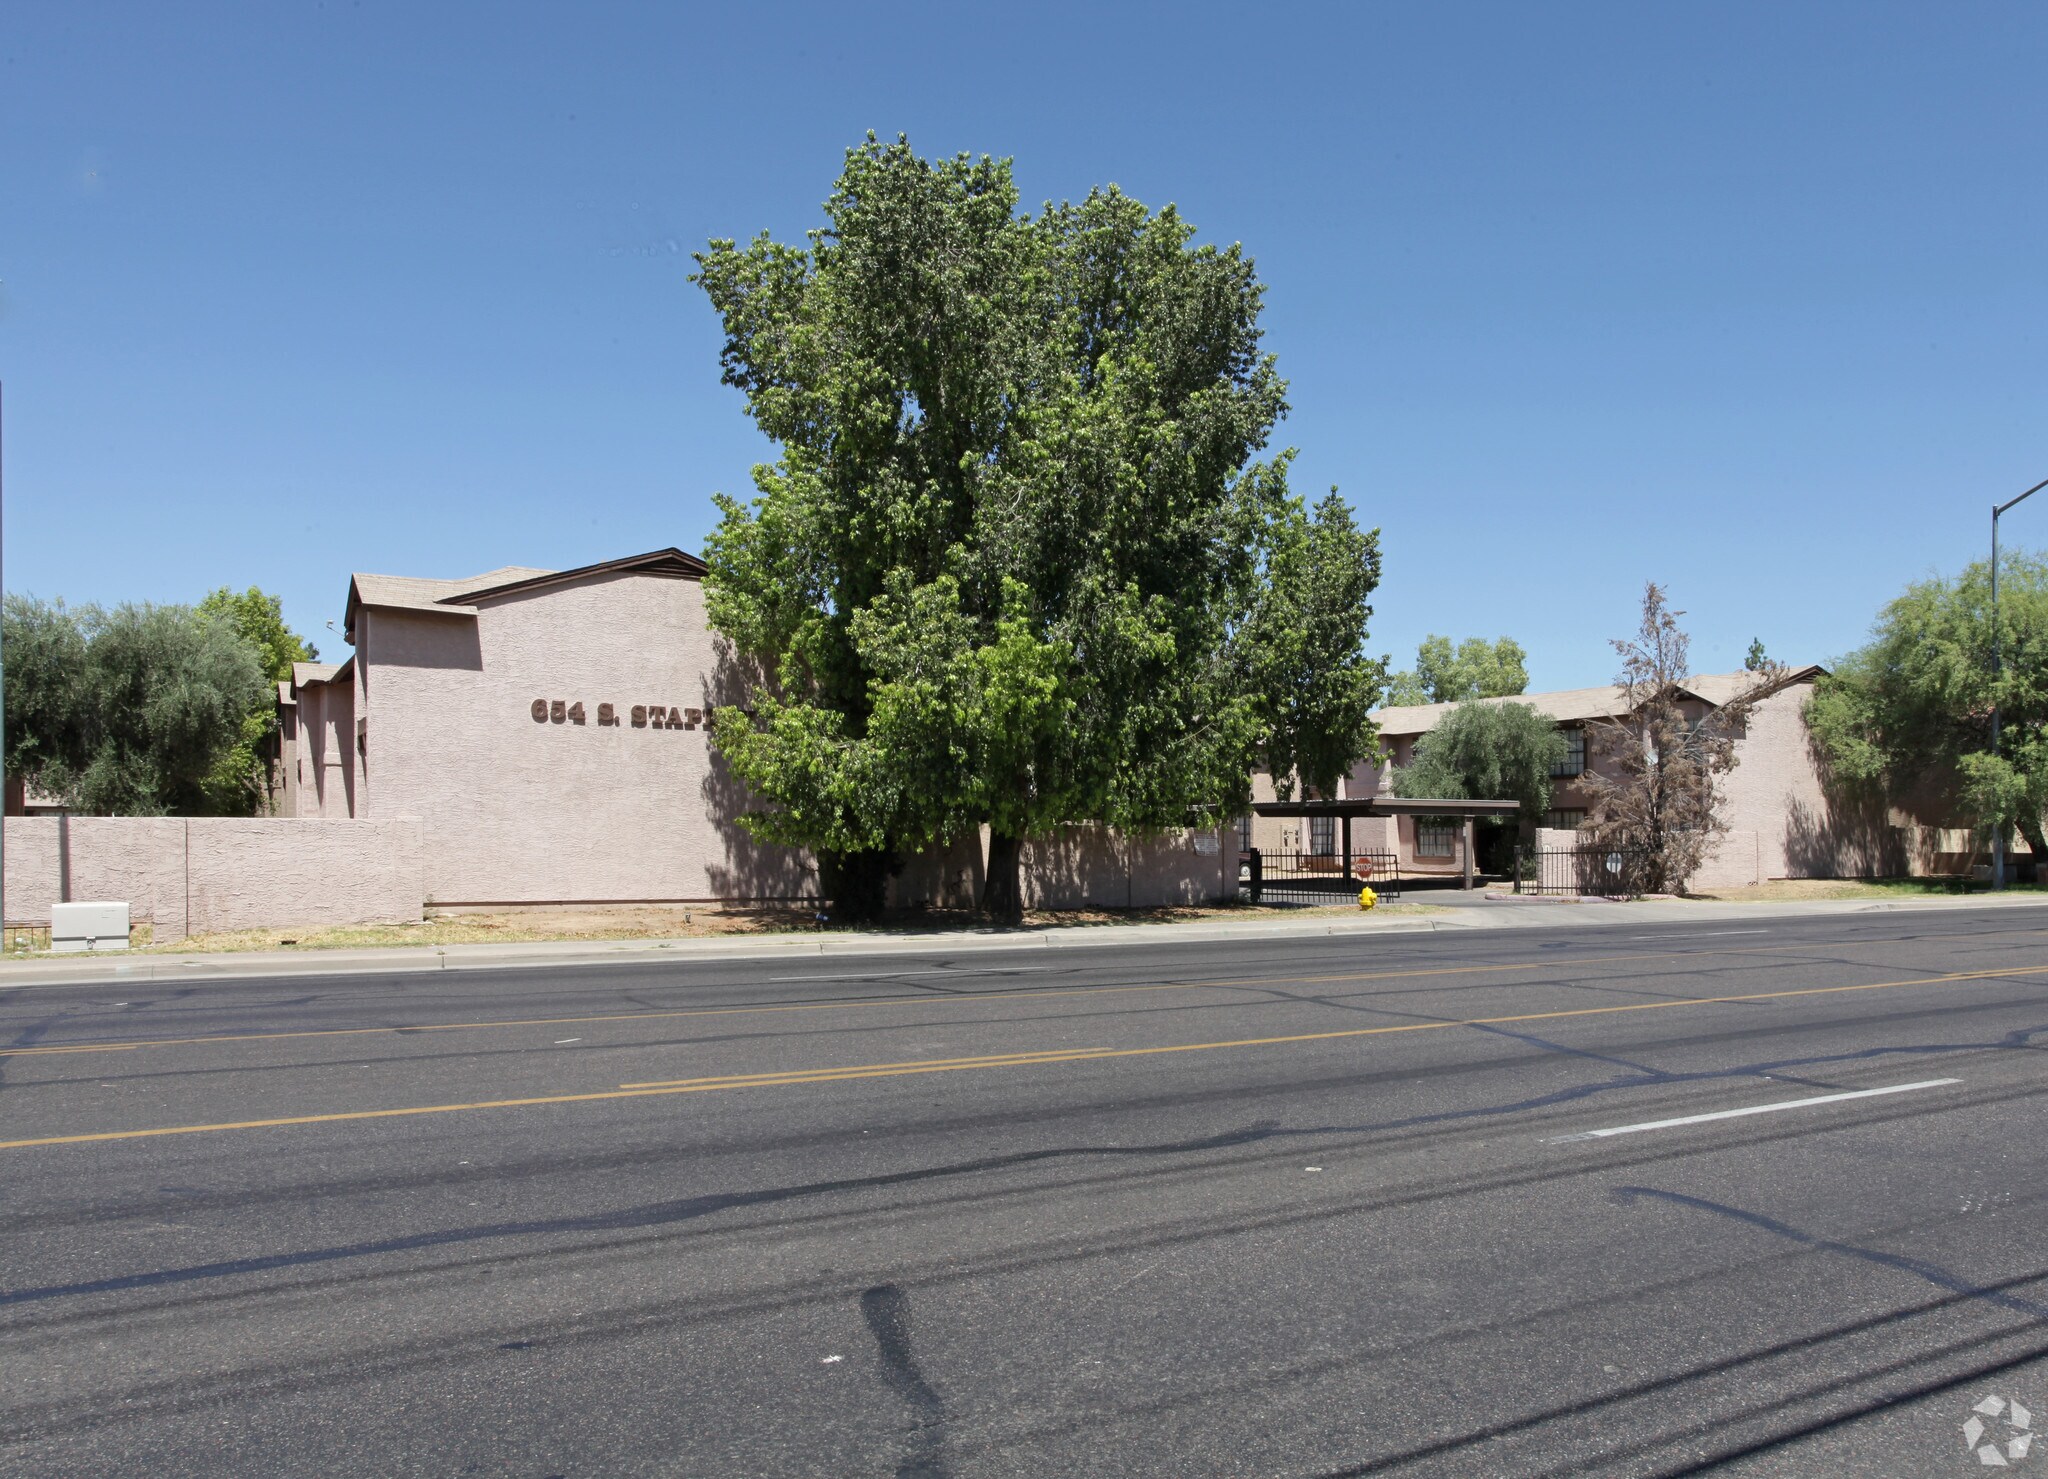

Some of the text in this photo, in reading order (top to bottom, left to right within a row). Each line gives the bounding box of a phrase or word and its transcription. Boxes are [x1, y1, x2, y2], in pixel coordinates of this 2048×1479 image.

[530, 698, 586, 724] 654
[597, 702, 620, 726] S.
[1356, 863, 1372, 872] STOP
